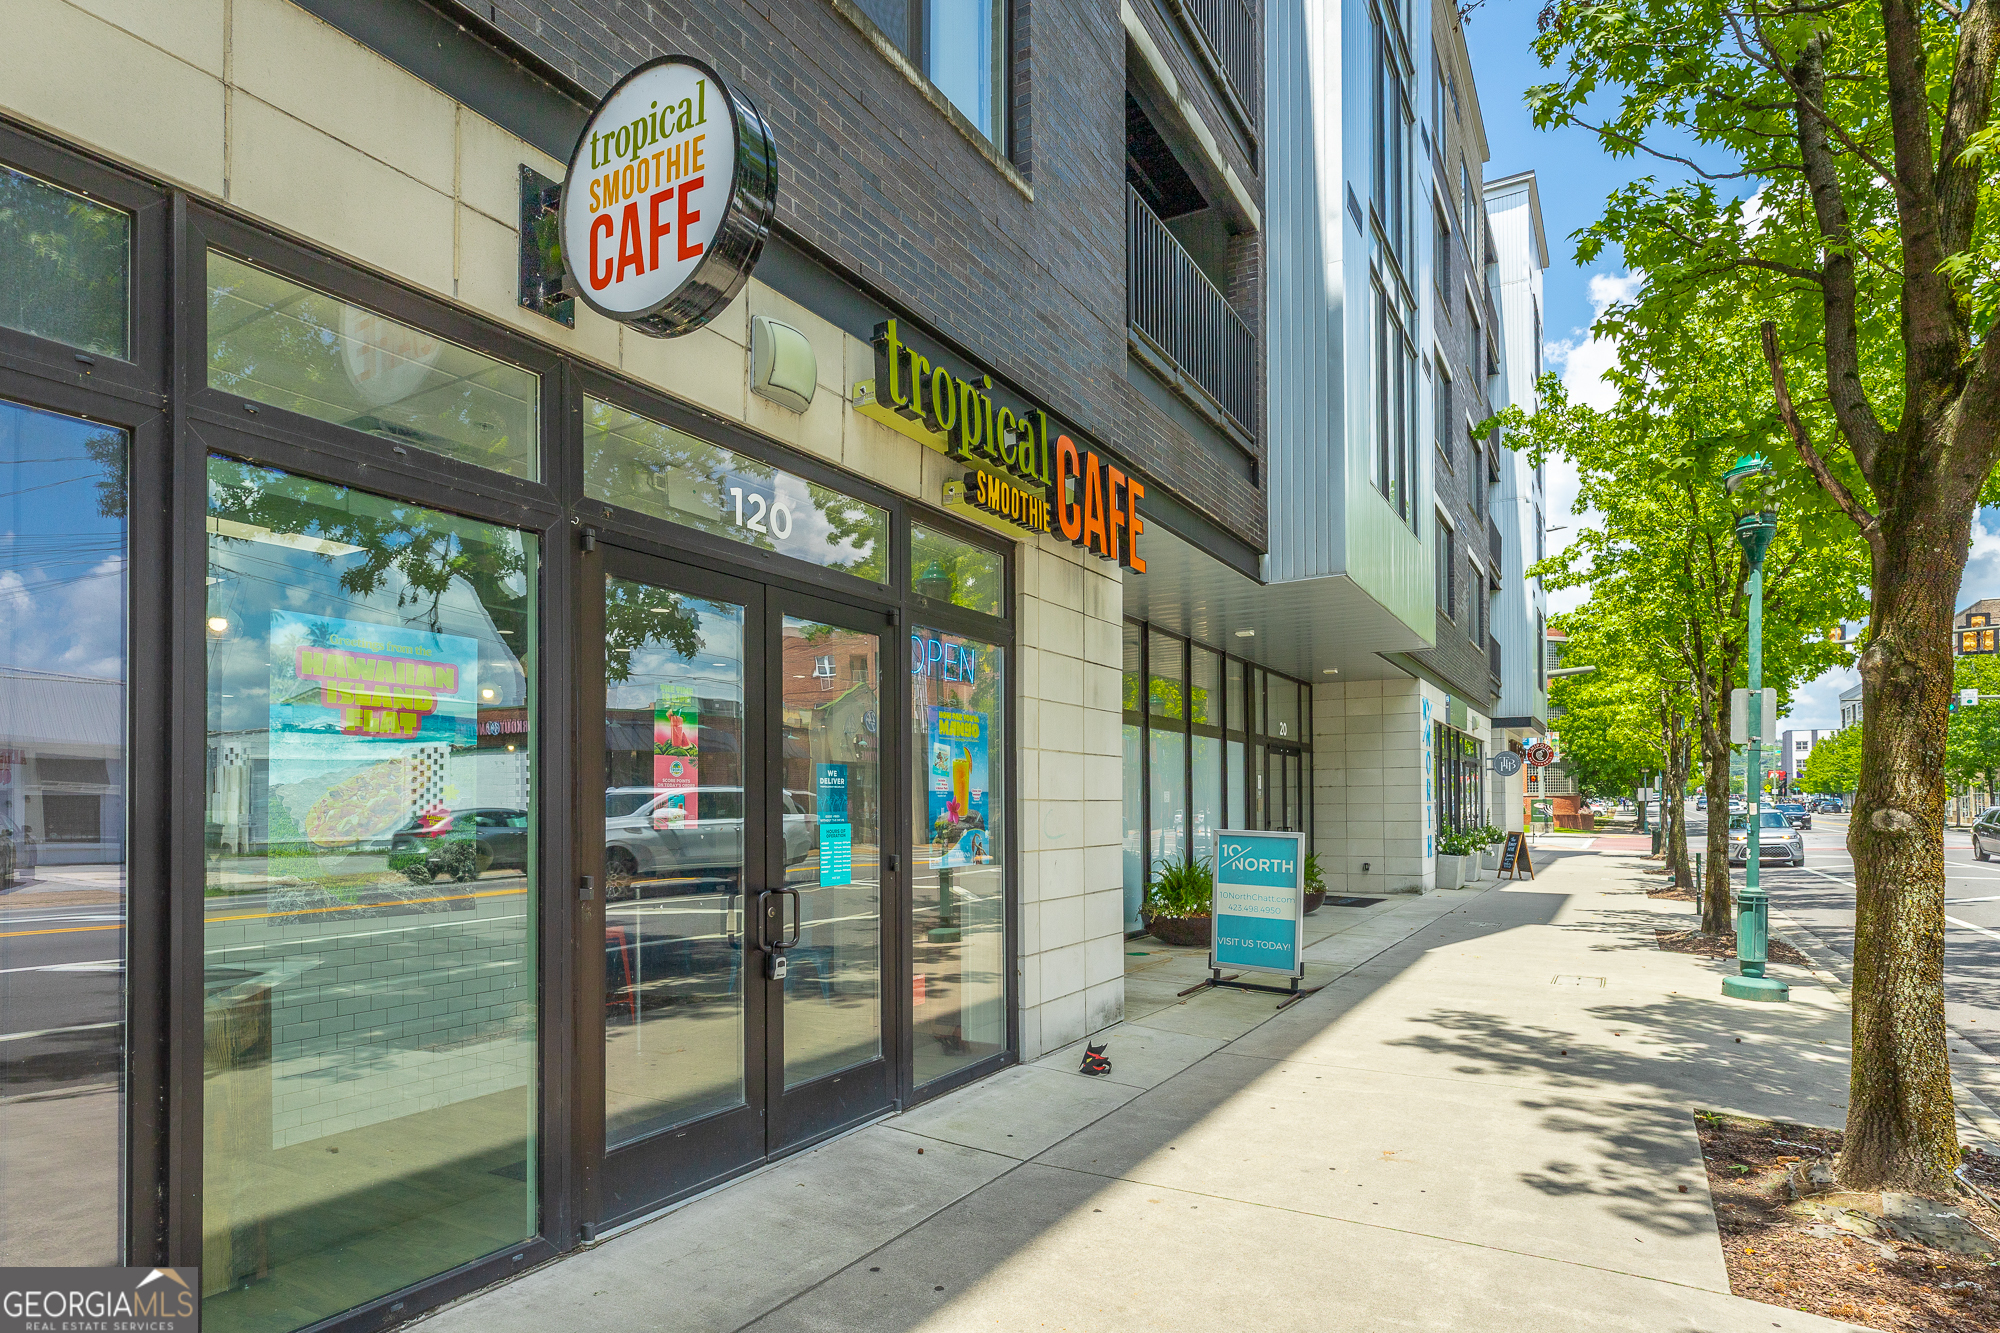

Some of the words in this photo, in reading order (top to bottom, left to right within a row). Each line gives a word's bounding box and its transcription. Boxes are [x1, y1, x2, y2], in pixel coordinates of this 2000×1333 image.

[589, 79, 708, 170] tropical
[589, 134, 706, 213] SMOOTHIE
[589, 176, 705, 291] CAFE
[882, 318, 1052, 486] tropical
[730, 487, 793, 540] 120
[975, 469, 1051, 533] SMOOTHIE
[1056, 434, 1147, 574] CAFE
[329, 634, 385, 652] Greetings
[387, 641, 414, 655] from
[415, 645, 433, 657] the
[301, 650, 455, 690] HAWAIIAN
[326, 680, 434, 711] ISLAND
[345, 707, 417, 735] FLAT
[938, 719, 980, 738] MANGO
[1279, 721, 1288, 737] 20
[819, 777, 845, 785] DELIVER
[827, 769, 838, 777] WE
[1231, 857, 1294, 874] NORTH
[1219, 891, 1296, 904] 10NorthChatt.com
[1228, 904, 1281, 915] 423.498.4950
[1217, 936, 1240, 947] VISIT
[1241, 938, 1254, 948] US
[1256, 940, 1291, 951] TODAY!
